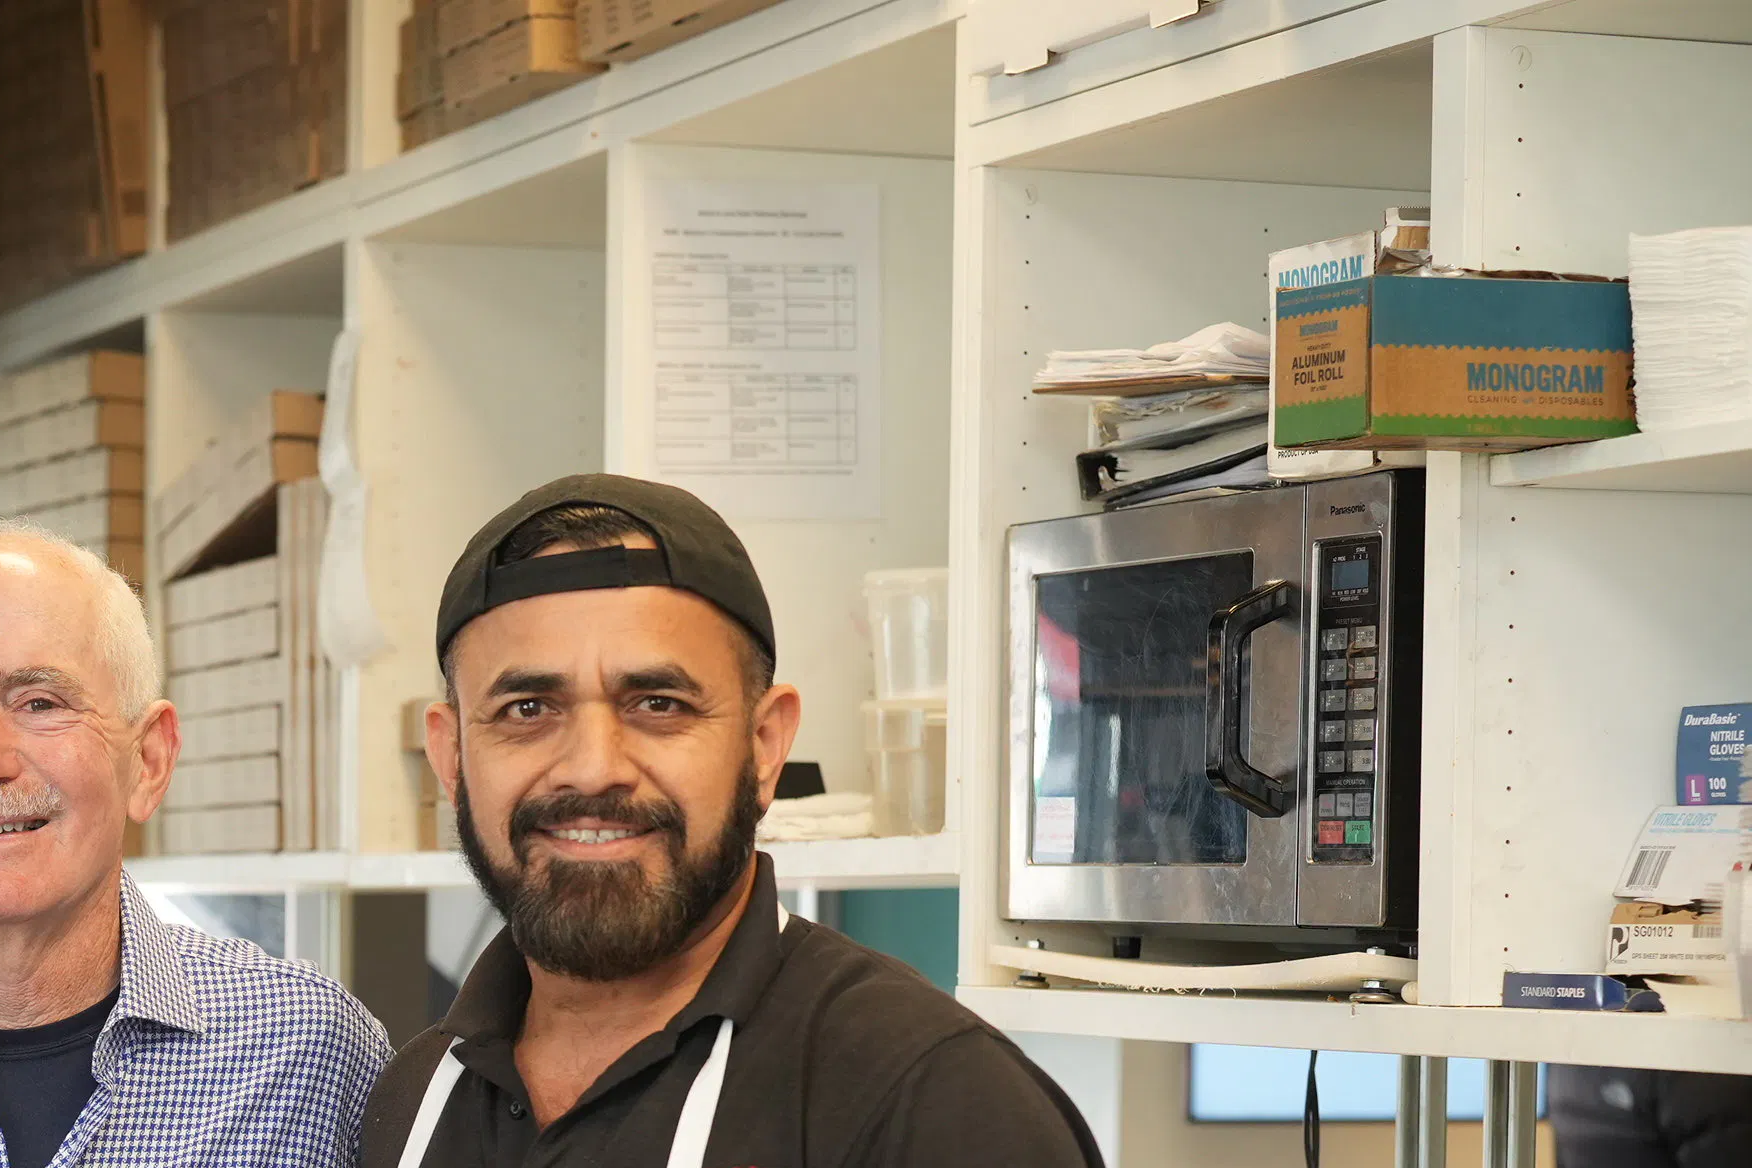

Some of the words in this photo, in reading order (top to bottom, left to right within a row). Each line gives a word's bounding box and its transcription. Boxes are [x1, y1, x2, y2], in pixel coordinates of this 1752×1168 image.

[1291, 350, 1346, 371] ALUMINUM
[1294, 370, 1316, 386] FOIL
[1318, 366, 1344, 383] ROLL
[1467, 363, 1604, 394] MONOGRAM
[1467, 395, 1518, 405] CLEANING
[1538, 396, 1605, 407] DISPOSABLES
[1330, 503, 1366, 516] Panasonic
[1684, 712, 1737, 726] DuraBasic
[1710, 730, 1745, 742] NITRILE
[1709, 743, 1745, 756] GLOVES
[1690, 779, 1701, 797] L
[1708, 777, 1727, 790] 100
[1633, 925, 1674, 938] SG01012
[1521, 986, 1556, 998] STANDARD
[1556, 987, 1586, 998] STAPLES
